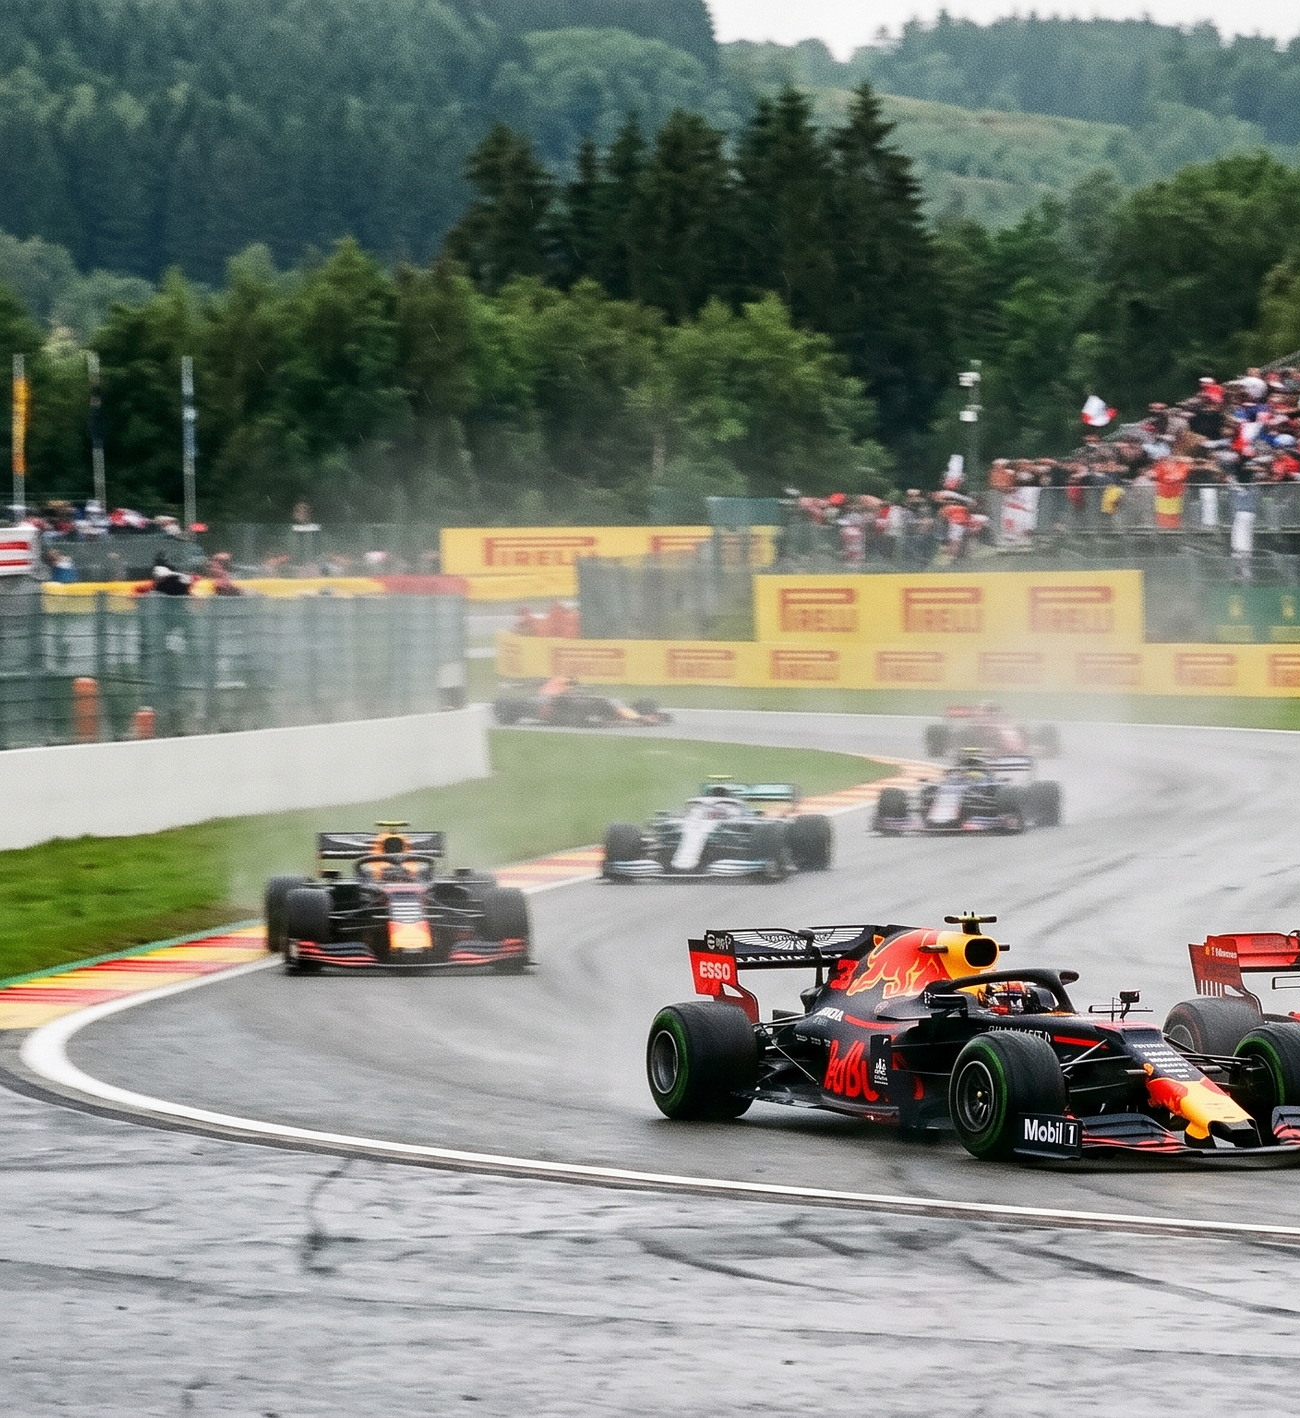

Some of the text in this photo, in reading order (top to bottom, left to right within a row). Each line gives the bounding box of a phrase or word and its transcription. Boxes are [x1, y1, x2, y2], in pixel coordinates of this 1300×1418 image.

[700, 960, 731, 981] ESSO
[1024, 1118, 1075, 1145] Mobil 1
